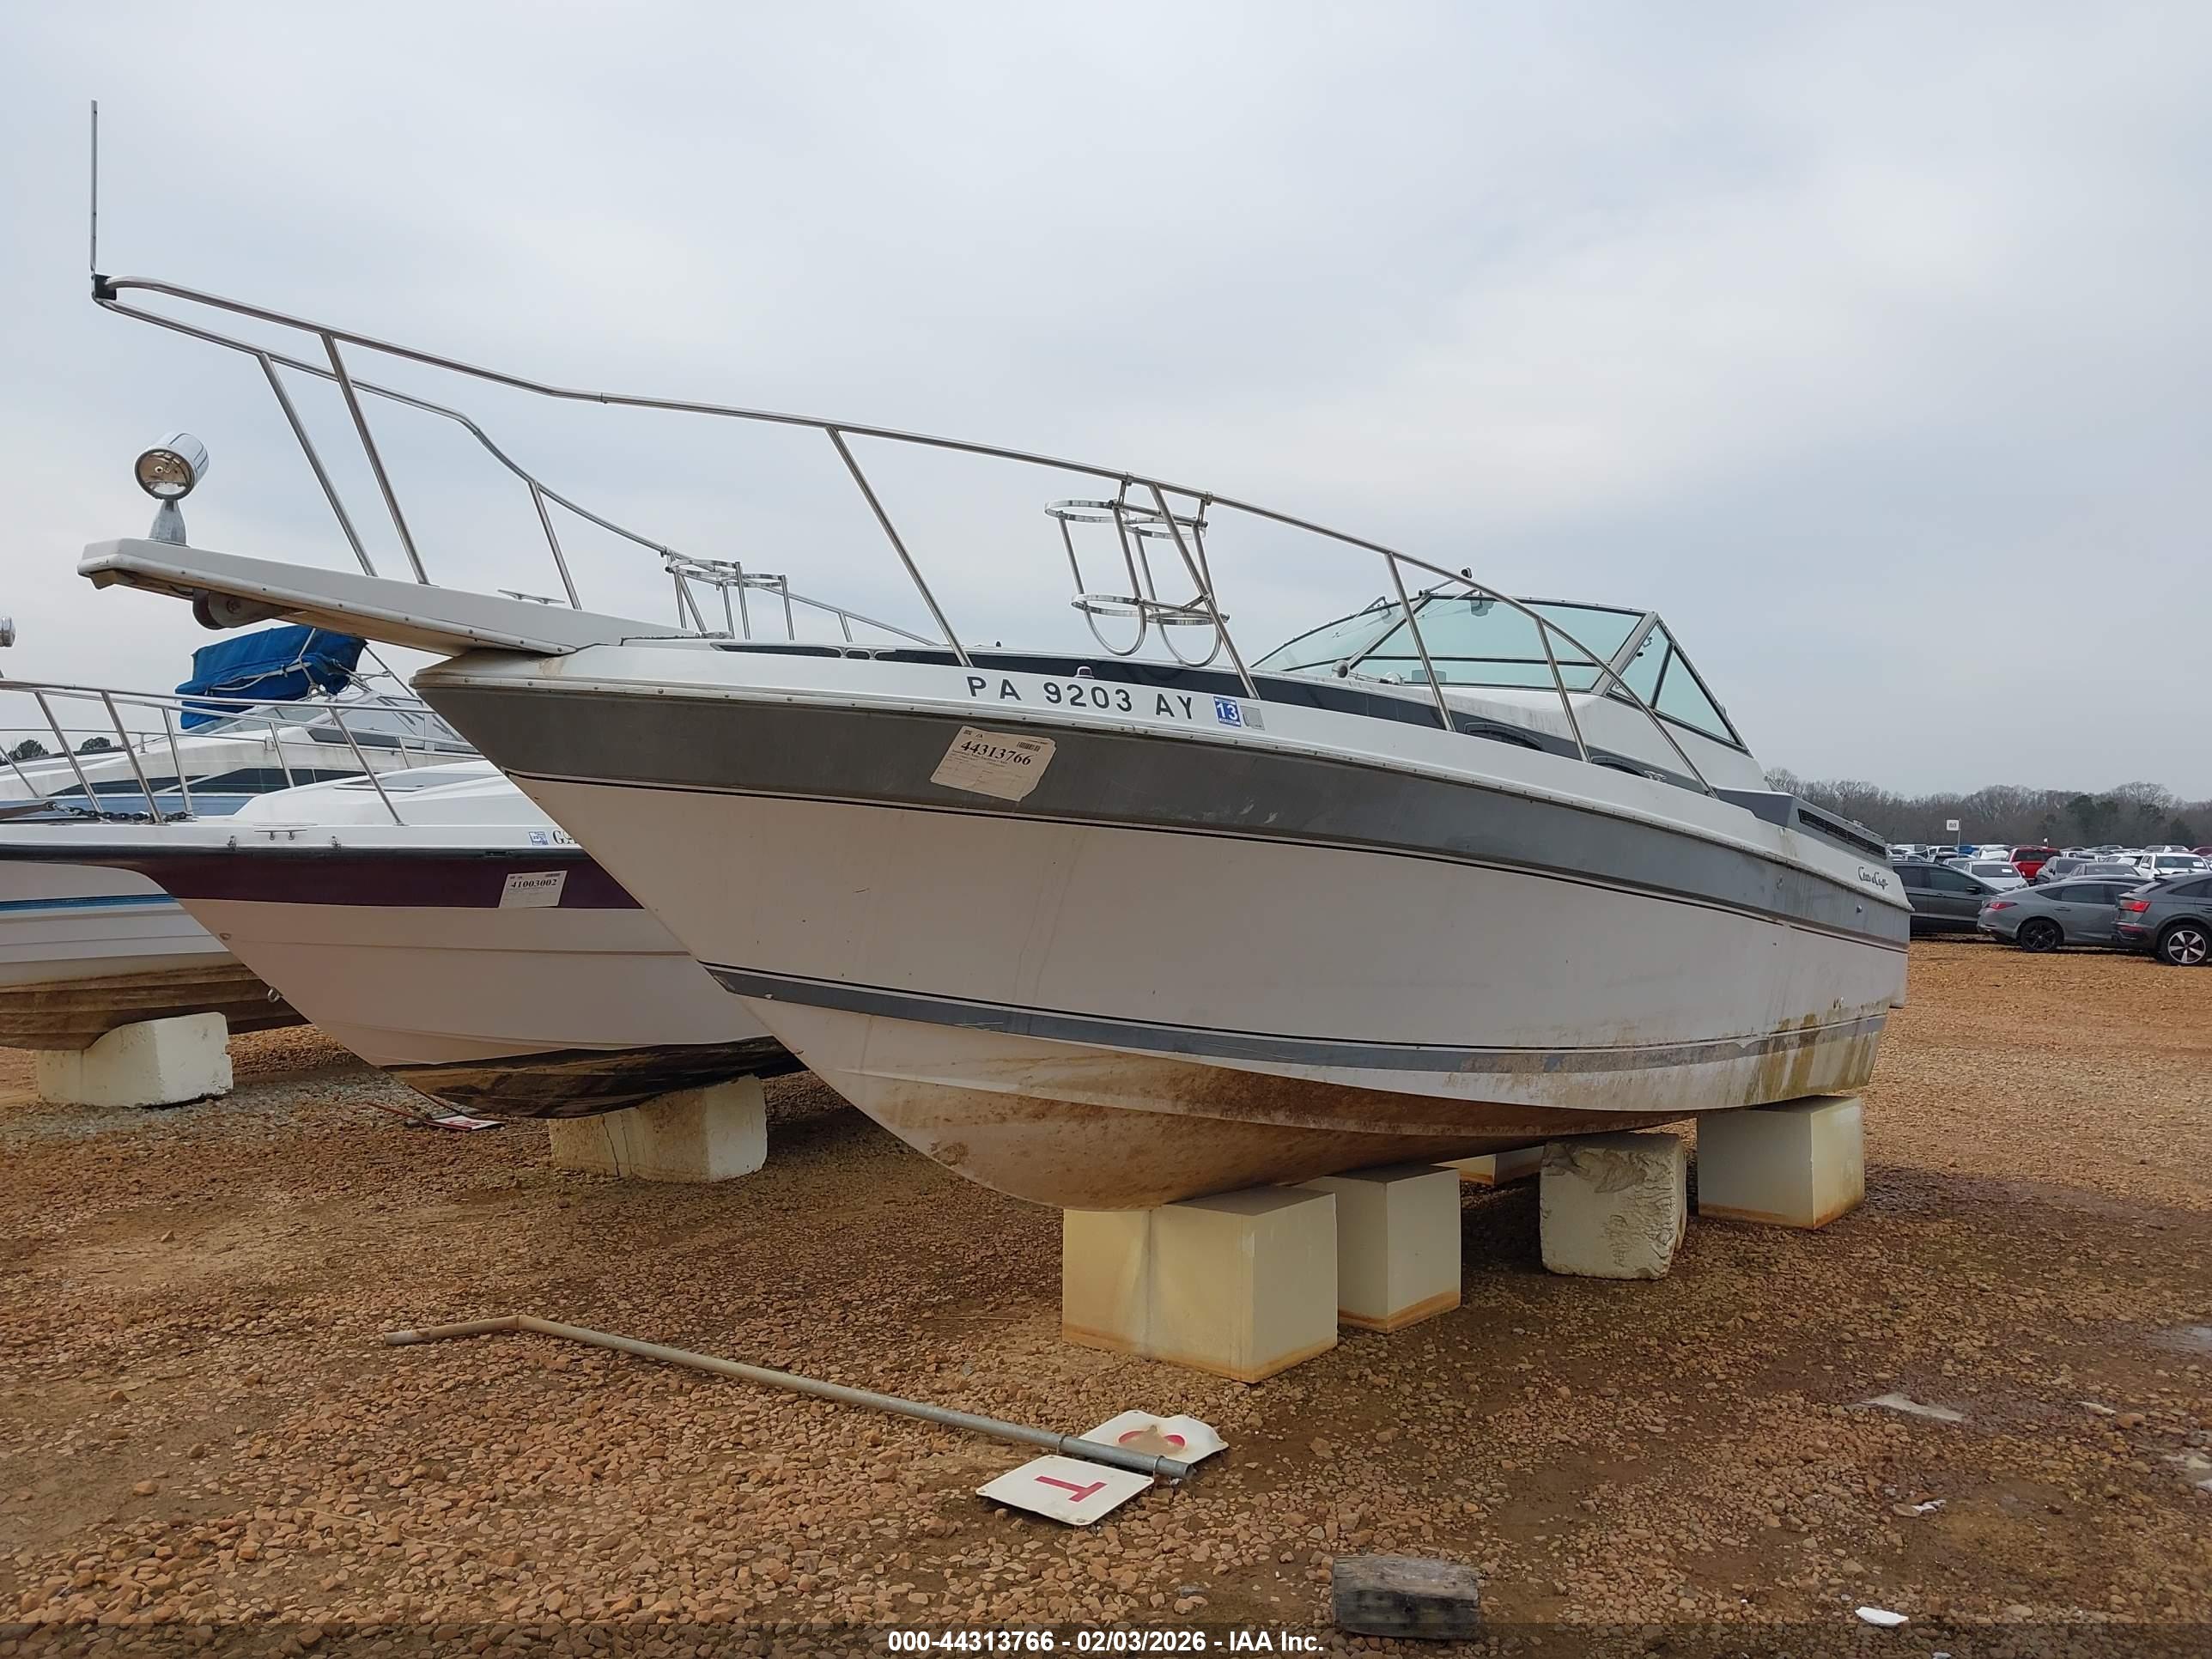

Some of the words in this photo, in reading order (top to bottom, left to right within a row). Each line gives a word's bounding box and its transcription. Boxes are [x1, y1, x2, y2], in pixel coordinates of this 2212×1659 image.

[967, 676, 1022, 701] PA
[1043, 682, 1133, 712] 9203
[1155, 693, 1194, 720] AY
[1216, 702, 1238, 721] 13
[960, 740, 1032, 766] 44313766
